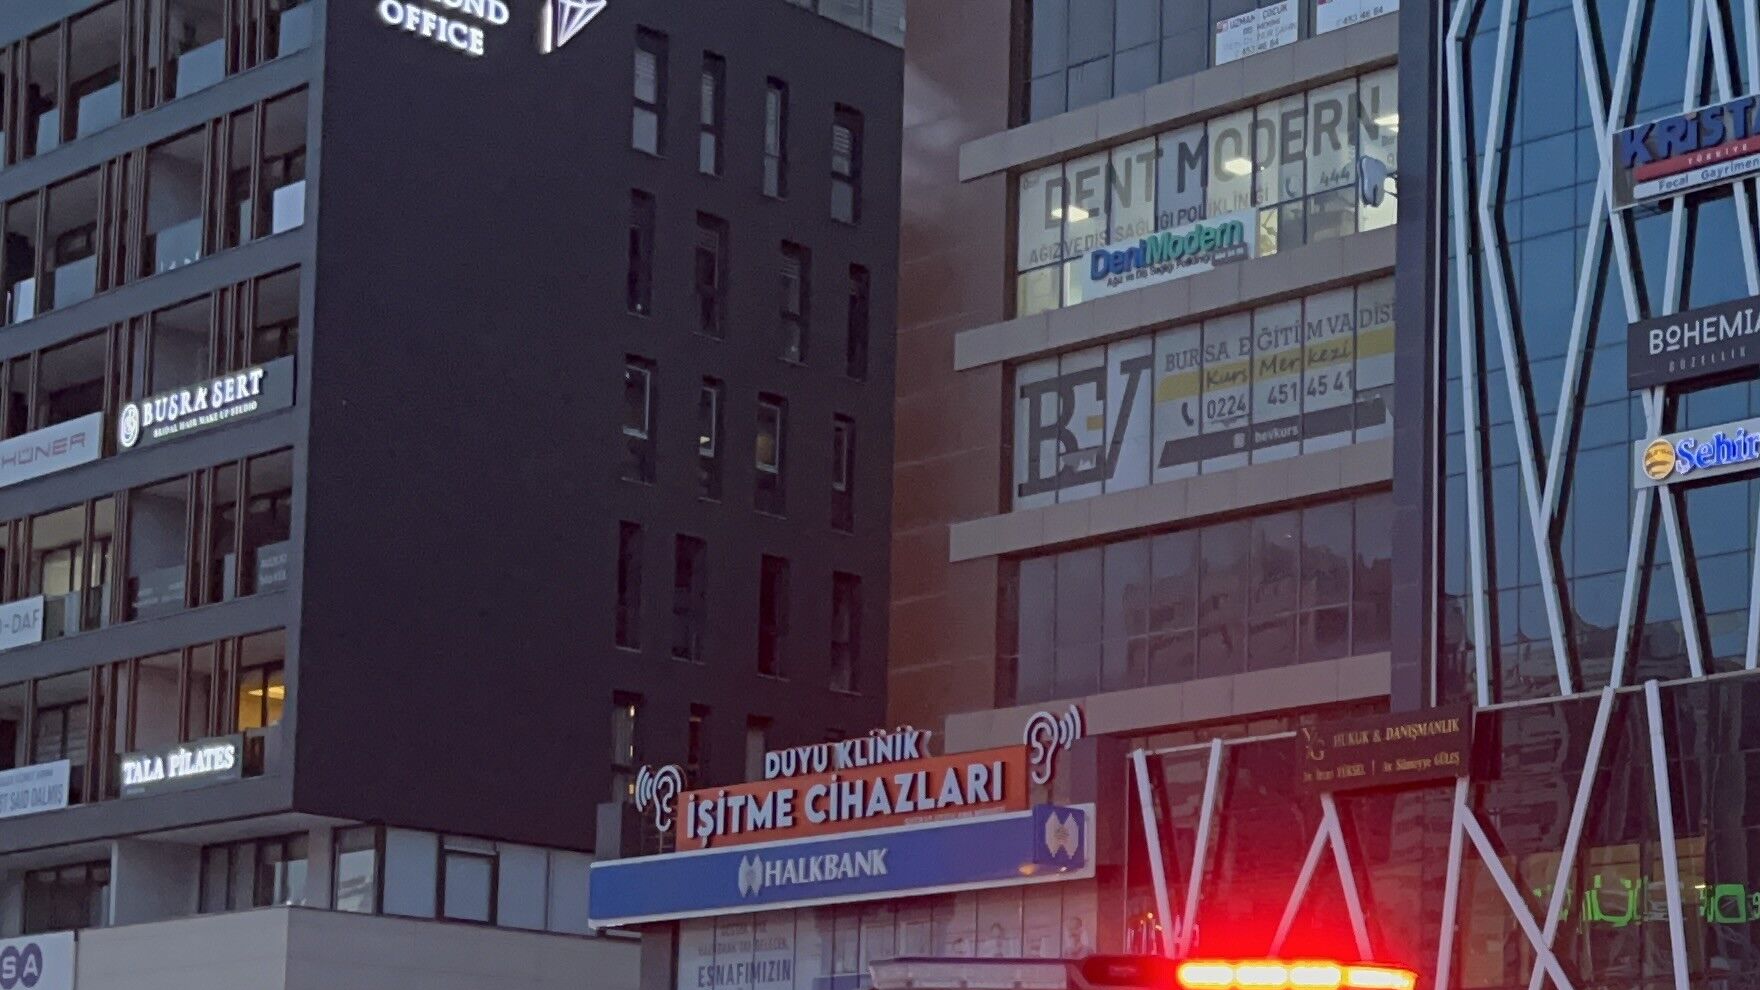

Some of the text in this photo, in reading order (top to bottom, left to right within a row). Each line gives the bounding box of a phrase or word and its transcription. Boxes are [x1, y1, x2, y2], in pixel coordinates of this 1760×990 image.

[379, 0, 484, 56] OFFICE
[1045, 86, 1381, 229] DENT MODERN
[1165, 341, 1230, 372] BURSA
[1238, 319, 1323, 356] EĞİTİM
[1206, 339, 1351, 388] Kurs Merkezi
[211, 367, 264, 408] SERT
[1206, 370, 1353, 420] 0224 451 45 41
[765, 725, 921, 780] DUYU KLİNİK
[1385, 718, 1461, 742] DANIŞMANLIK
[121, 744, 236, 786] TALA PİLATES
[687, 759, 1004, 847] İŞİTME CİHAZLARI
[765, 848, 889, 888] HALKBANK
[697, 958, 792, 988] ESNAFIMIZIN
